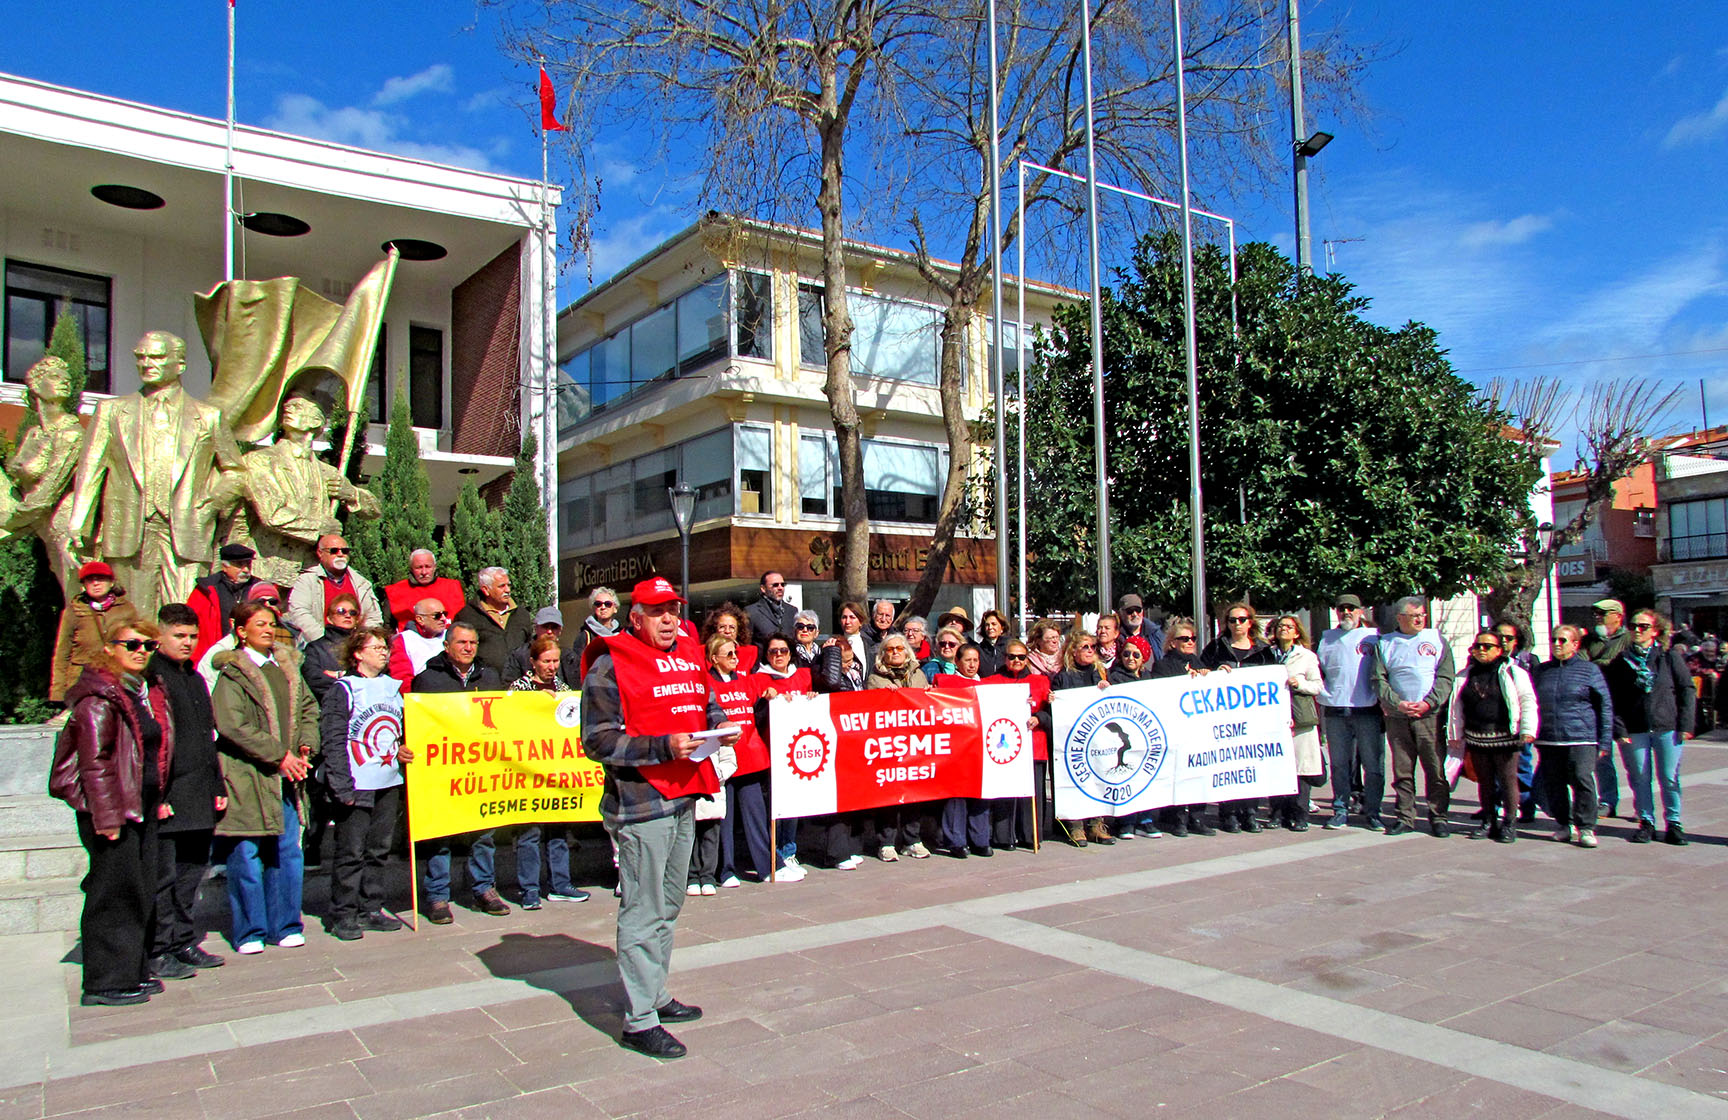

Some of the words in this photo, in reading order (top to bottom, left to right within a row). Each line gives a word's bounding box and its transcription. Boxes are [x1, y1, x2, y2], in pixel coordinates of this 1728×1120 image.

[583, 561, 619, 586] Garanti
[619, 552, 656, 581] BBVA
[1558, 560, 1585, 577] OES
[653, 680, 695, 698] EMEKLİ
[1179, 681, 1280, 718] ÇEKADDER
[839, 713, 870, 732] DEV
[875, 705, 975, 730] EMEKLİ-SEN
[1073, 712, 1099, 745] KADIN
[1097, 702, 1153, 730] DAYANIŞMA
[1212, 721, 1248, 741] ÇEŞME
[863, 733, 952, 765] ÇEŞME
[1187, 750, 1218, 768] KADIN
[1219, 742, 1284, 763] DAYANIŞMA
[875, 763, 936, 787] ŞUBESİ
[1070, 746, 1092, 783] ÇEŞME
[1212, 766, 1257, 788] DERNEĞİ
[449, 768, 526, 796] KÜLTÜR
[533, 766, 605, 788] DERNEĞ
[1103, 784, 1132, 802] 2020
[479, 800, 527, 818] ÇEŞME
[531, 794, 583, 813] ŞUBESİ
